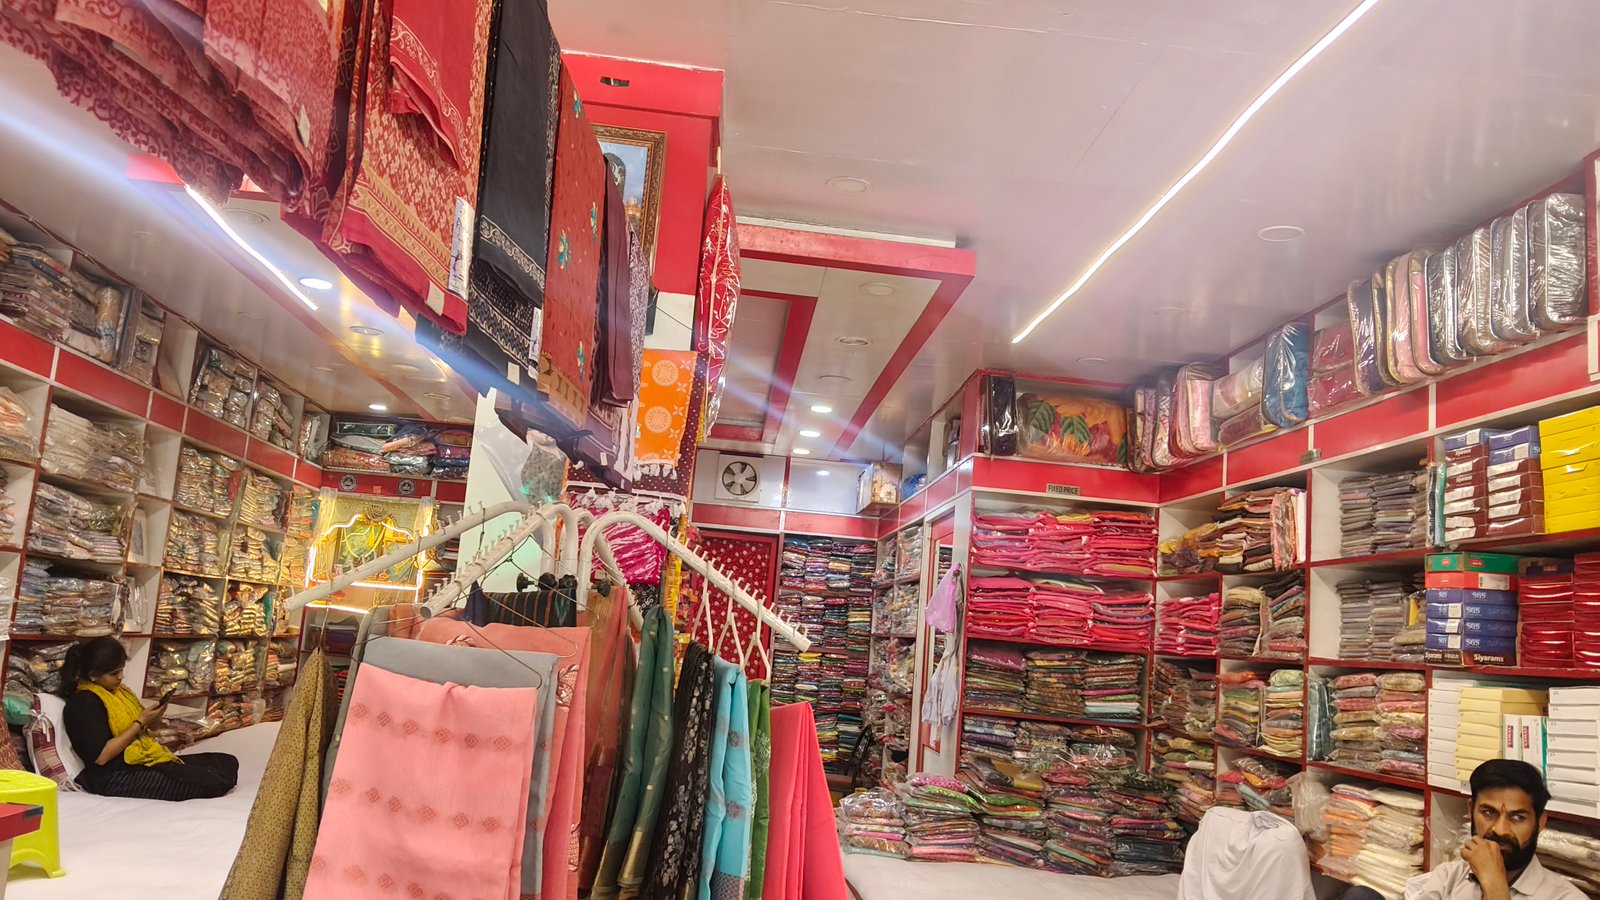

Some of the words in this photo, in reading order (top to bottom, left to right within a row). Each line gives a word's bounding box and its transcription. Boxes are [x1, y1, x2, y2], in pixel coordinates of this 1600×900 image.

[1048, 484, 1062, 493] FIXED
[1064, 486, 1079, 495] PRICE
[1472, 591, 1487, 600] SGS
[1465, 606, 1480, 614] SGS
[1465, 622, 1480, 631] SGS
[1465, 638, 1480, 647] SGS
[1473, 653, 1504, 663] Siyarams
